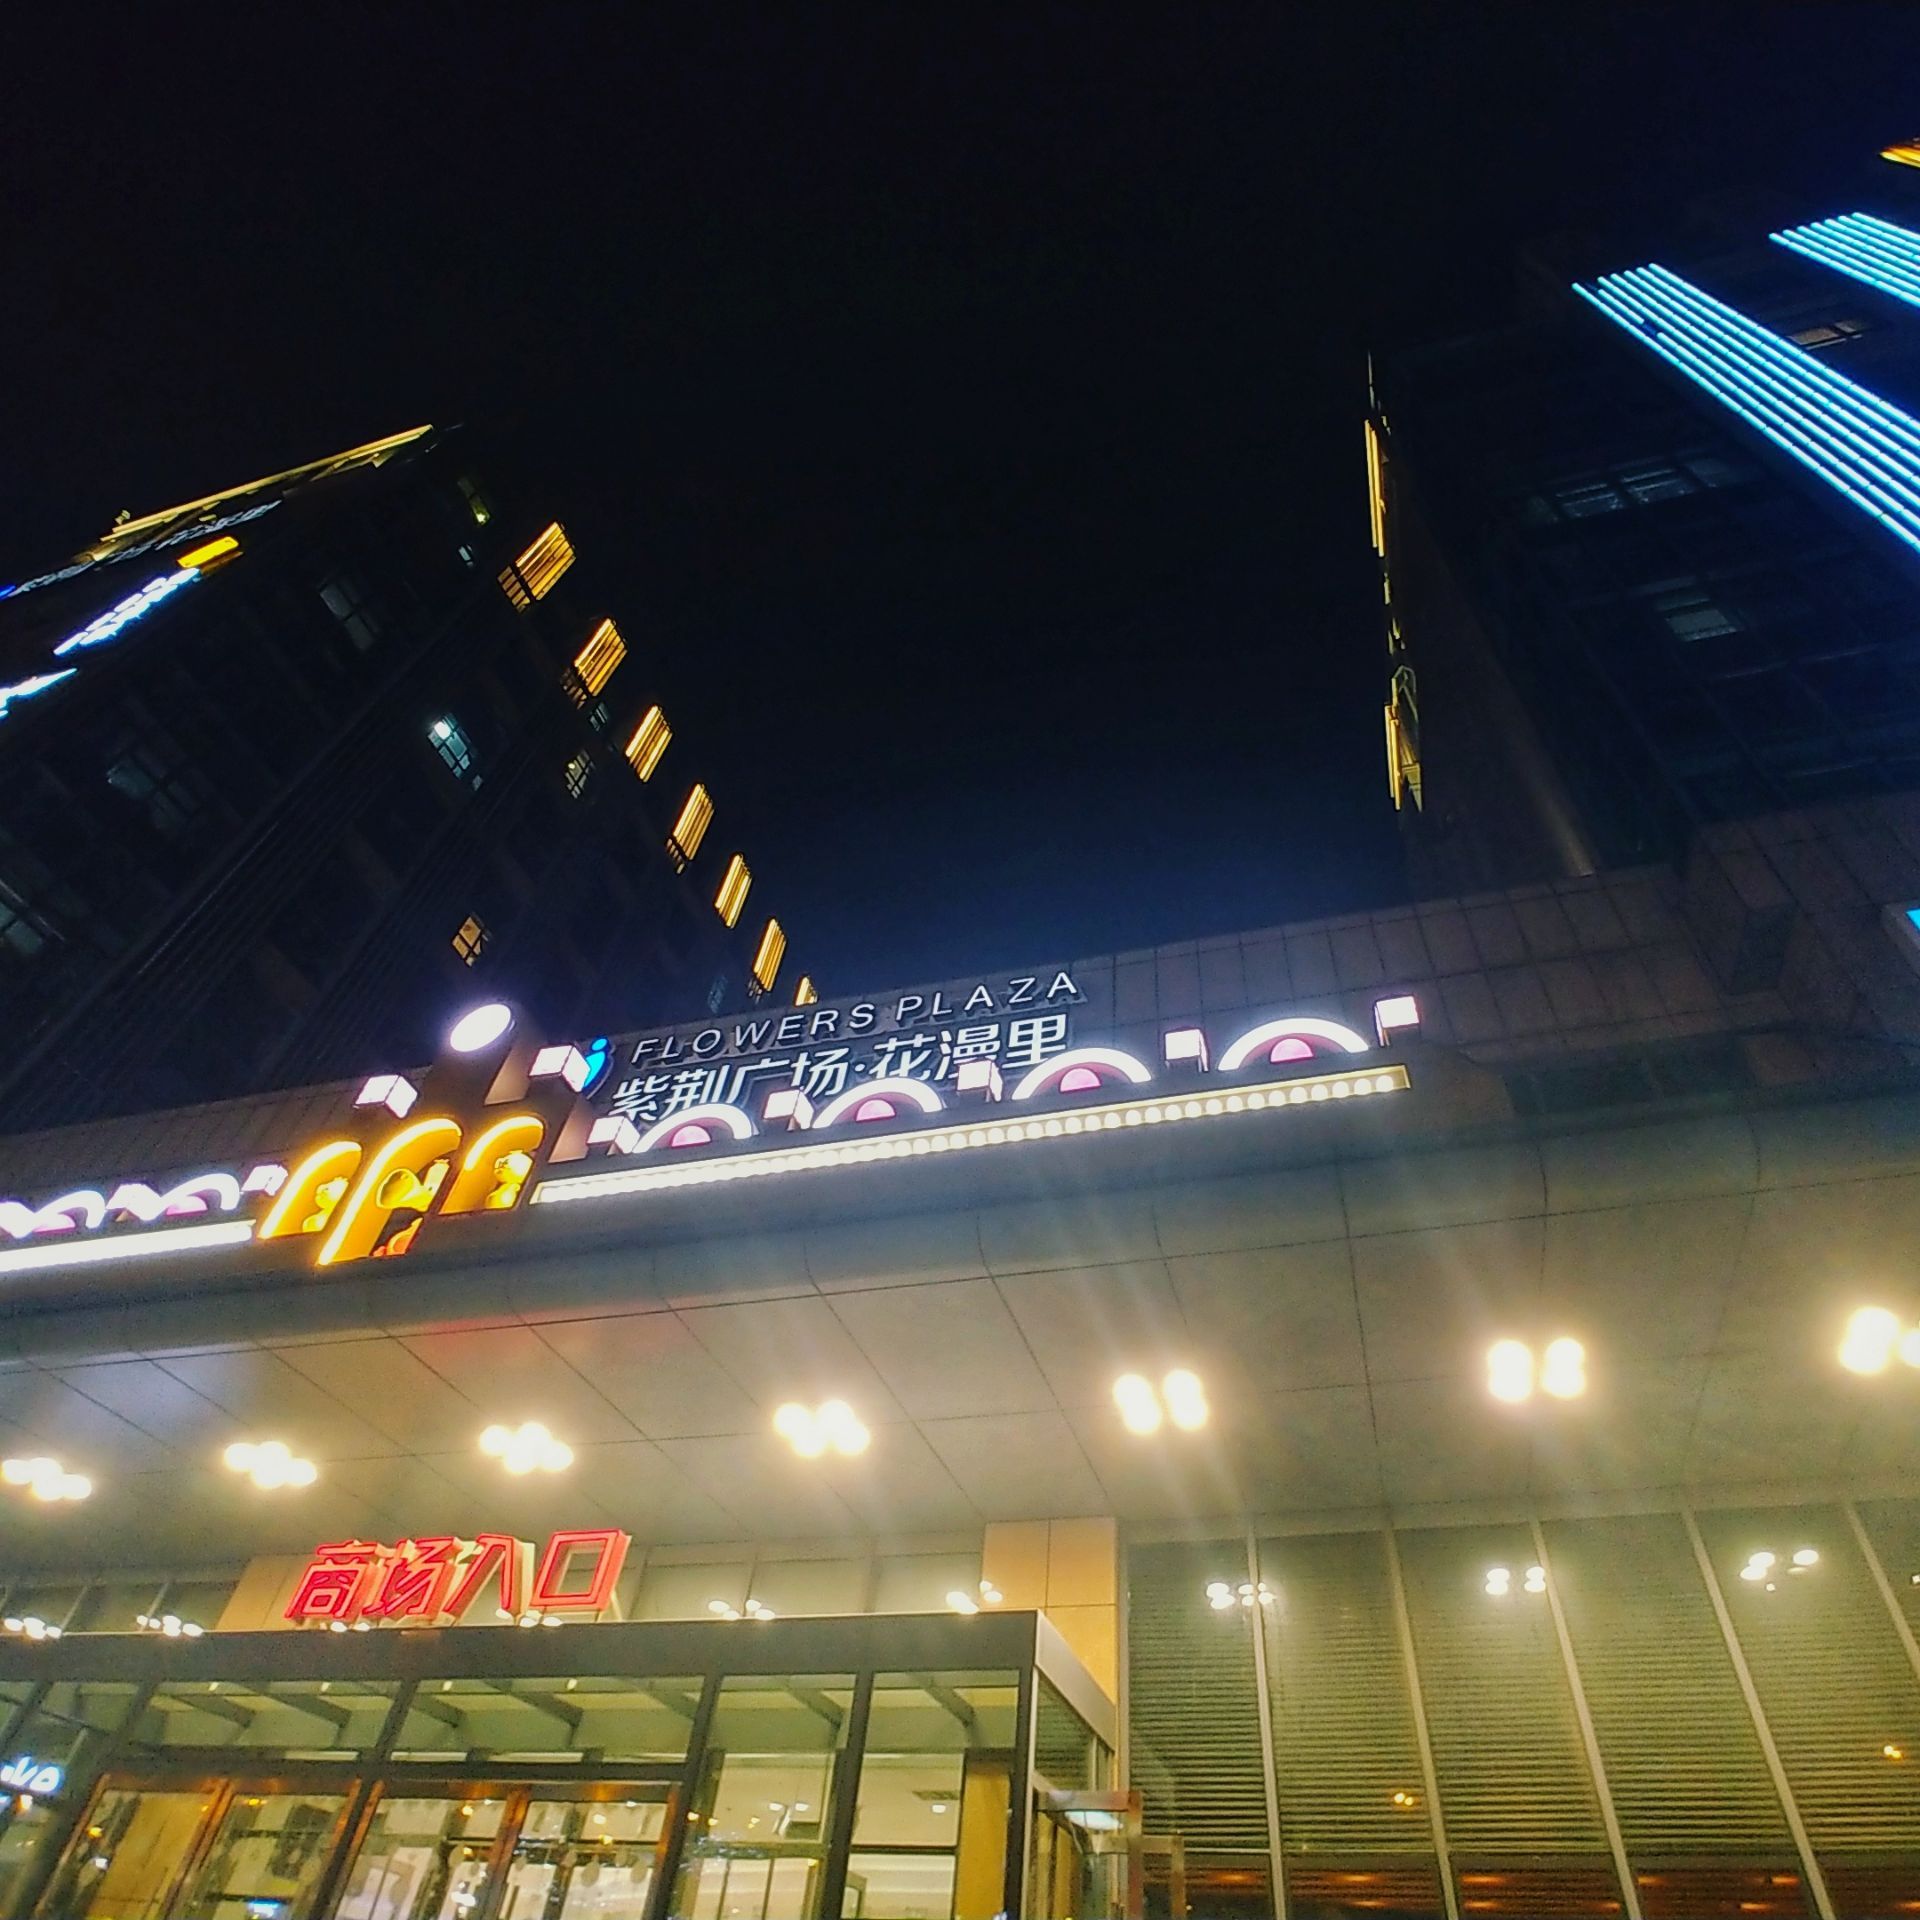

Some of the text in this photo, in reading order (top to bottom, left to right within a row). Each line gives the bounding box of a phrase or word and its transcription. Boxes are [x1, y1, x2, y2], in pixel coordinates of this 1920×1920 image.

[631, 971, 1078, 1064] FLOWERS PLAZA
[284, 1528, 627, 1620] 商场入口
